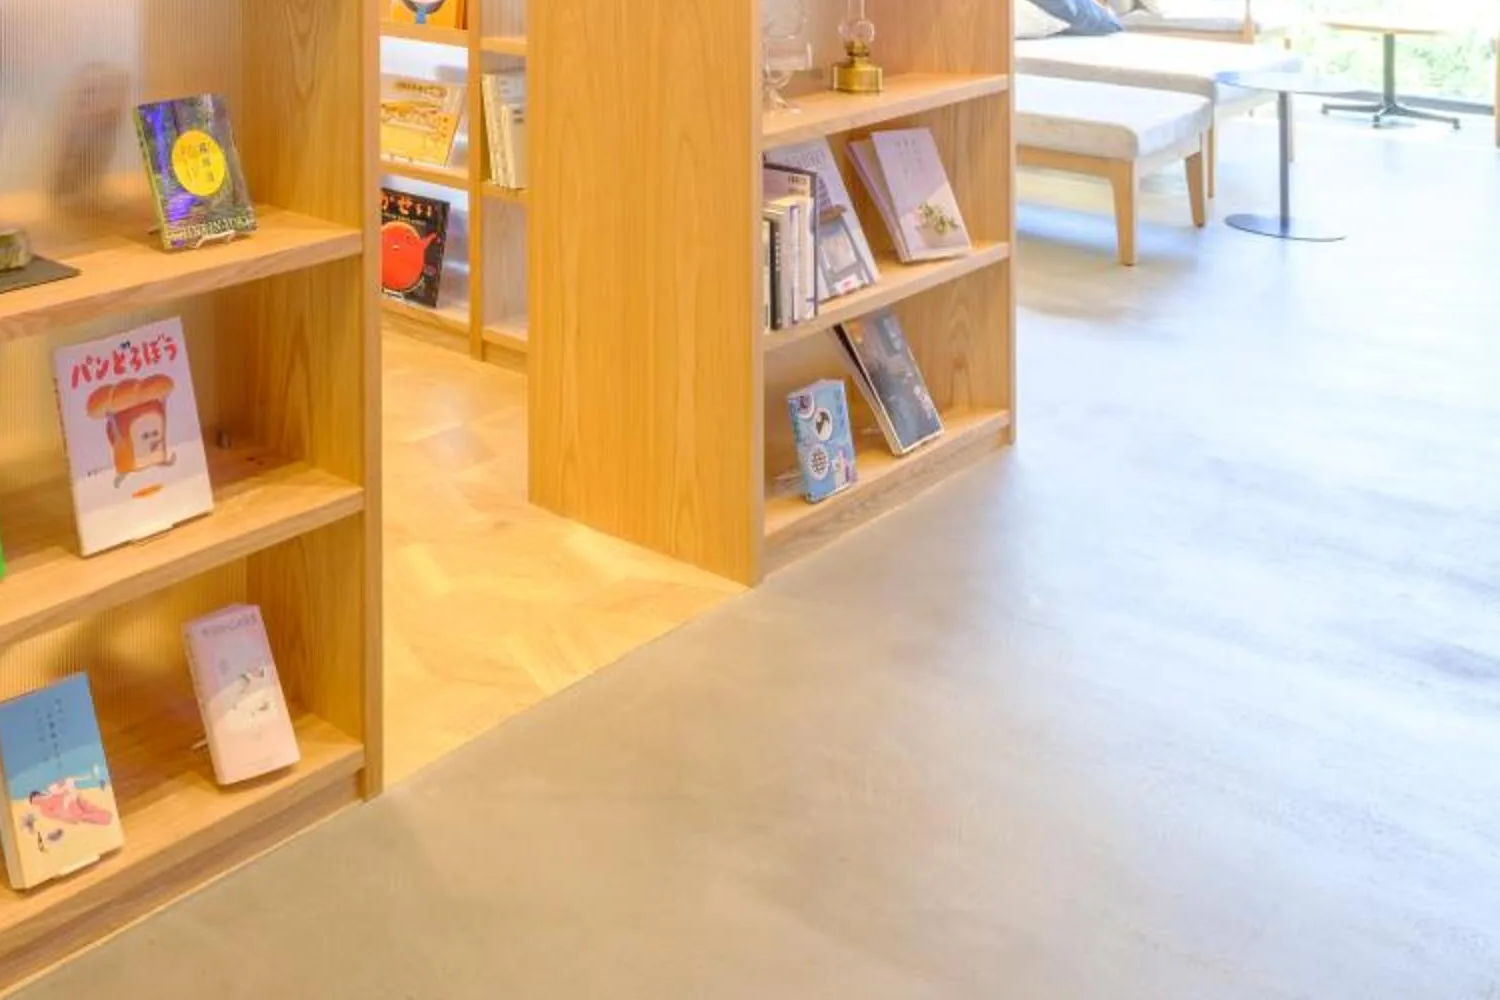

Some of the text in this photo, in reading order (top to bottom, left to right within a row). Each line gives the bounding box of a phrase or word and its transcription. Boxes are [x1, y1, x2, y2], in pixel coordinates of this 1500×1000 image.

[71, 335, 177, 389] パンどろぼう
